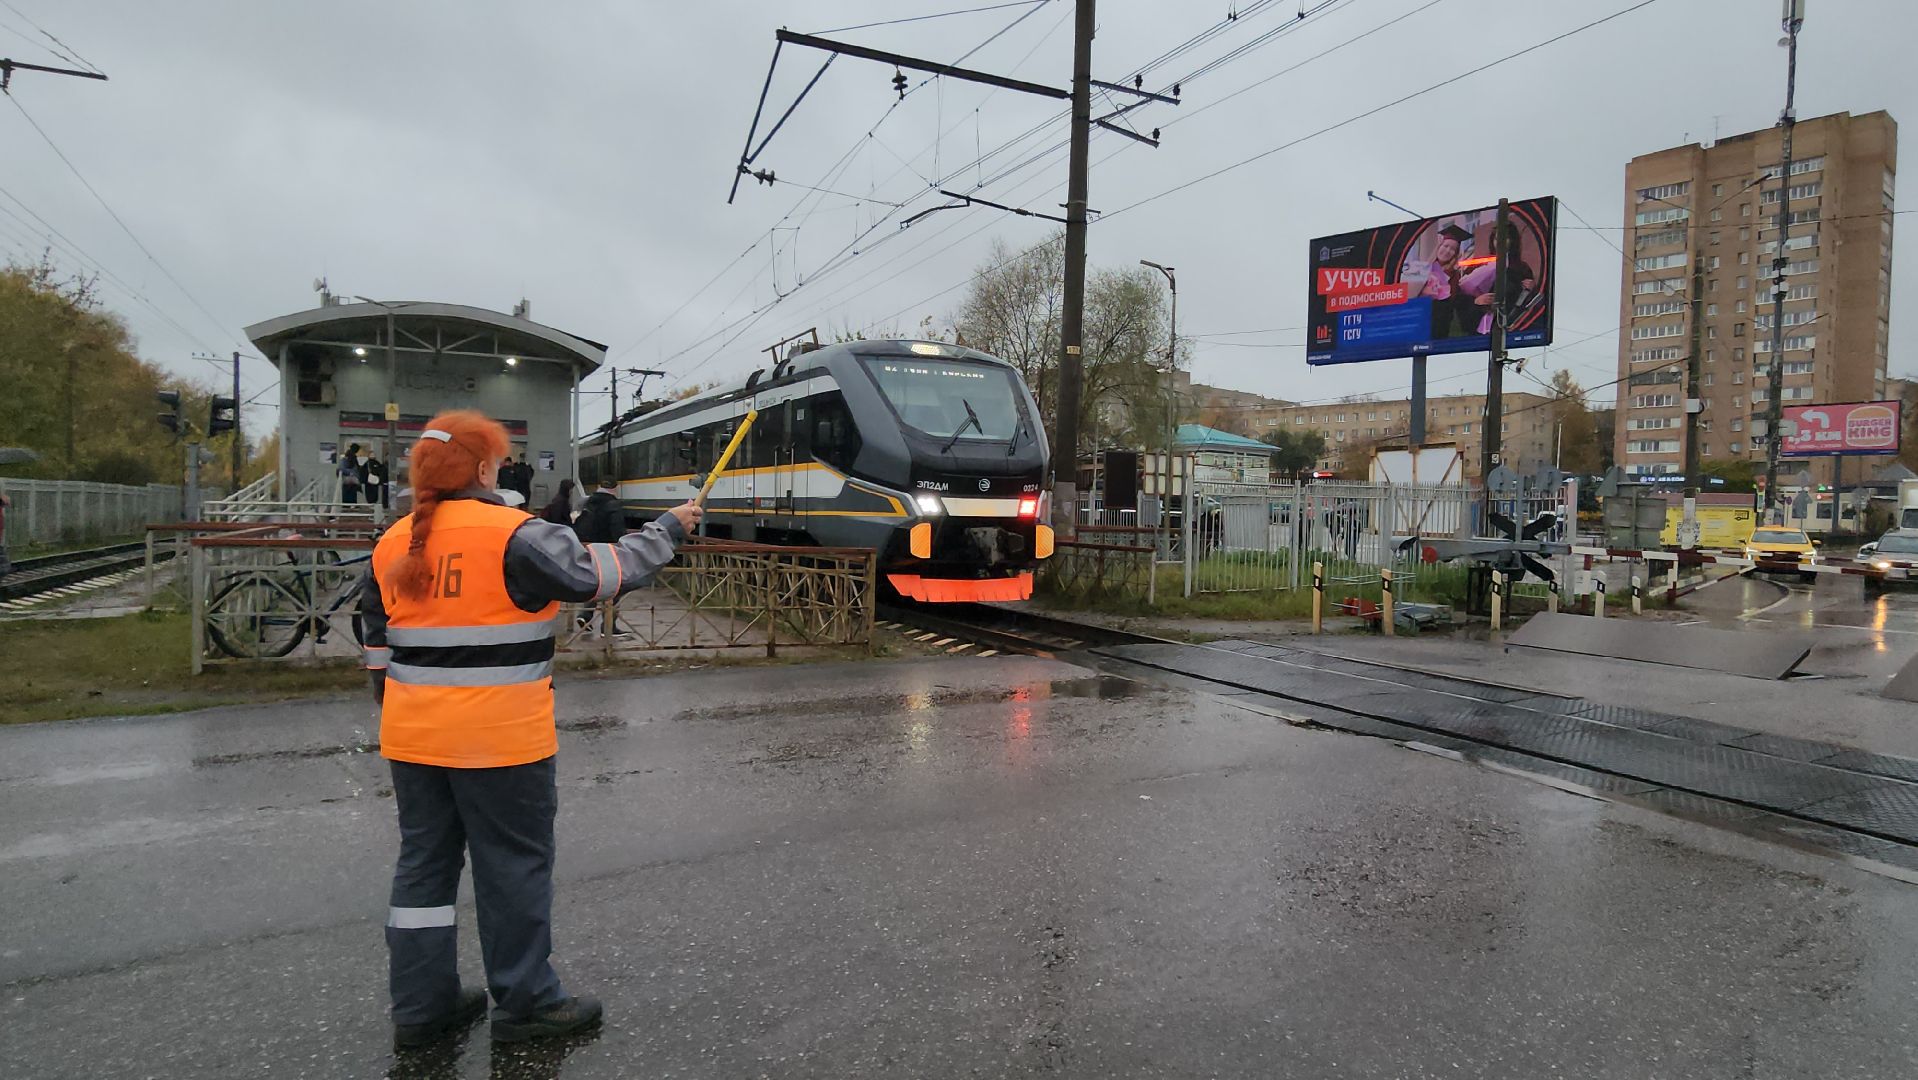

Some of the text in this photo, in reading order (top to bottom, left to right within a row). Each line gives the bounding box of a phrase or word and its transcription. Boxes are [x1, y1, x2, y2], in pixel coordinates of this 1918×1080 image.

[1325, 270, 1381, 292] УЧУСЬ
[1338, 288, 1404, 306] ПОДМОСКОВЬЕ
[1343, 313, 1362, 326] ГГТУ
[1343, 328, 1361, 341] ГСГУ
[1848, 418, 1892, 428] BURGER
[1848, 427, 1891, 438] KING
[916, 480, 949, 491] ЭП2ДМ
